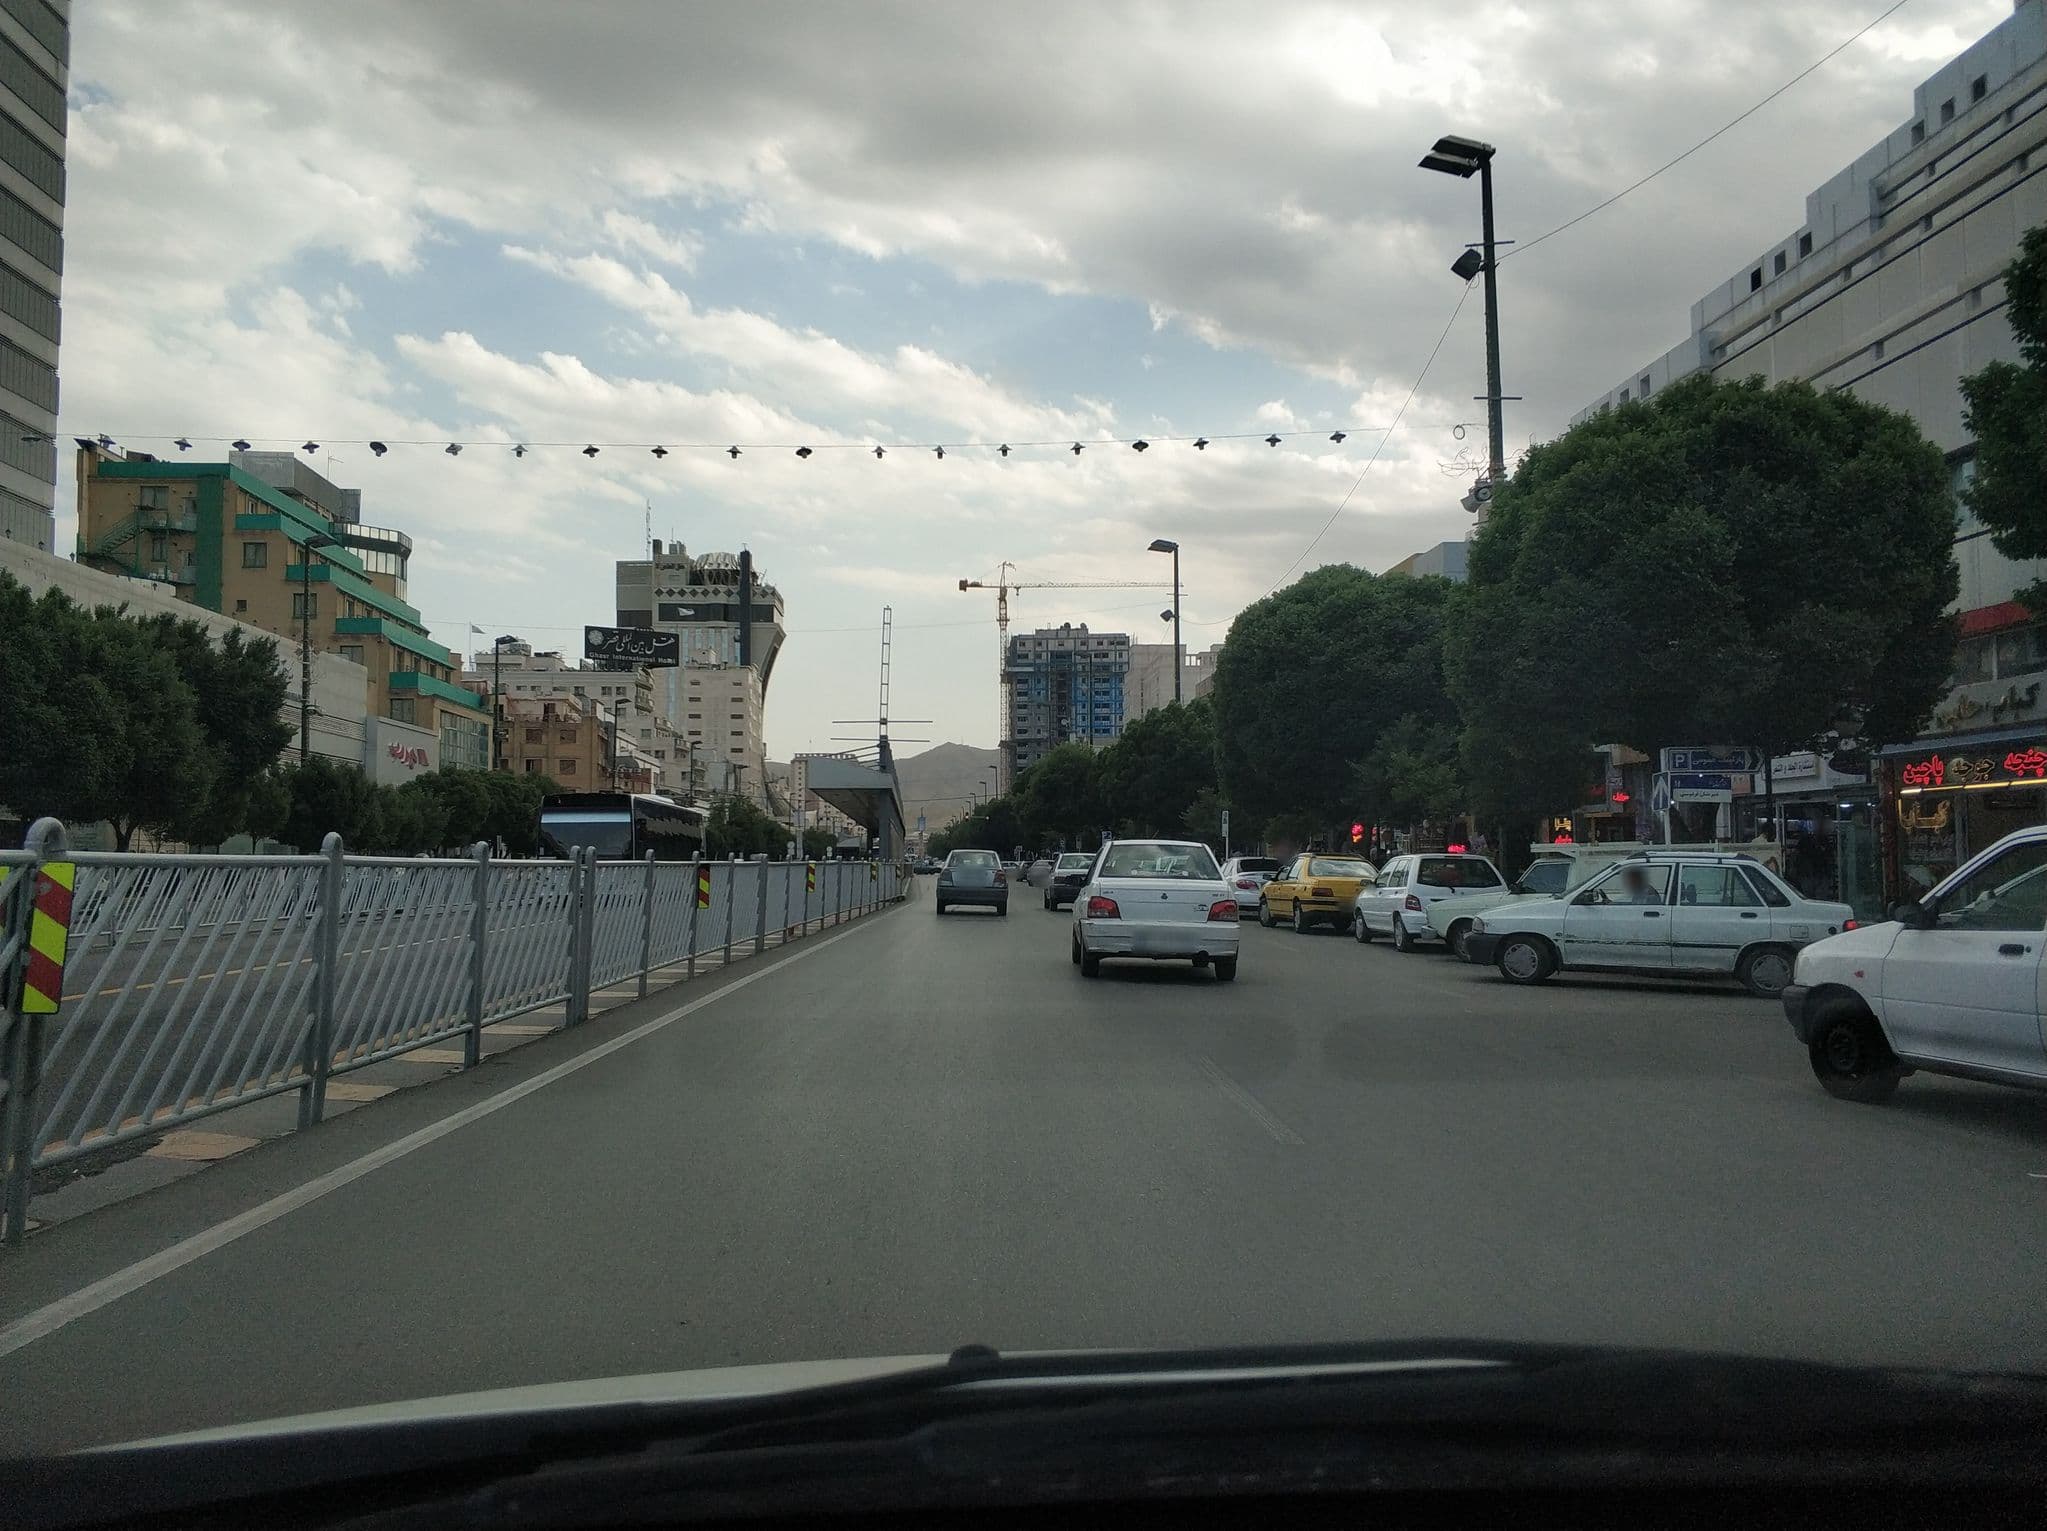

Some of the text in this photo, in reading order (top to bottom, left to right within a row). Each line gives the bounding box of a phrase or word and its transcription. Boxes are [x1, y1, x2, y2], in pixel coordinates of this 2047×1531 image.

[615, 631, 634, 652] المللی
[630, 640, 645, 655] بین
[645, 636, 676, 654] هتل
[612, 653, 656, 663] International
[1675, 754, 1686, 768] P
[1902, 754, 1945, 785] پاچین
